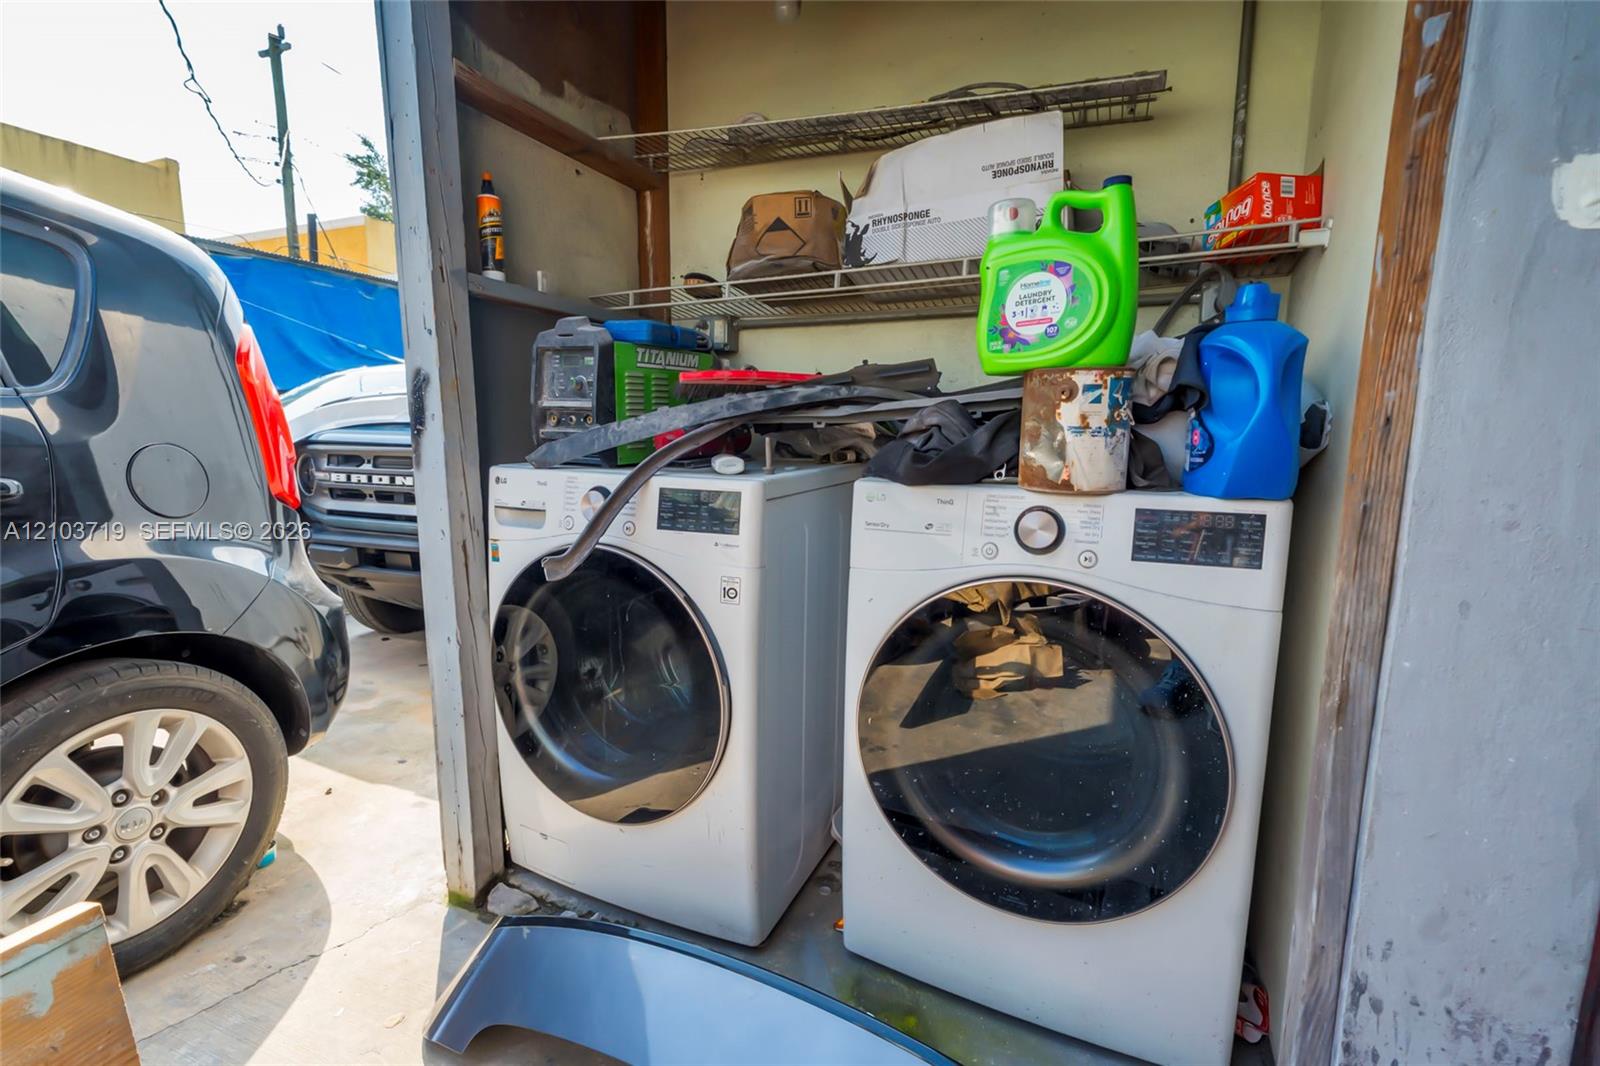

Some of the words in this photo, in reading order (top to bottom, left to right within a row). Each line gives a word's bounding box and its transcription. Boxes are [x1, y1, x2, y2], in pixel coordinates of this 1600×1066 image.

[991, 160, 1054, 179] RHYNOSPONGE
[1260, 181, 1273, 218] bounce
[872, 208, 931, 228] RHYNOSPONGE
[927, 216, 942, 225] AUTO
[1015, 295, 1056, 307] DETERGENT
[1018, 289, 1053, 300] LAUNDRY
[1046, 326, 1058, 334] 107
[636, 347, 699, 368] TITANIUM
